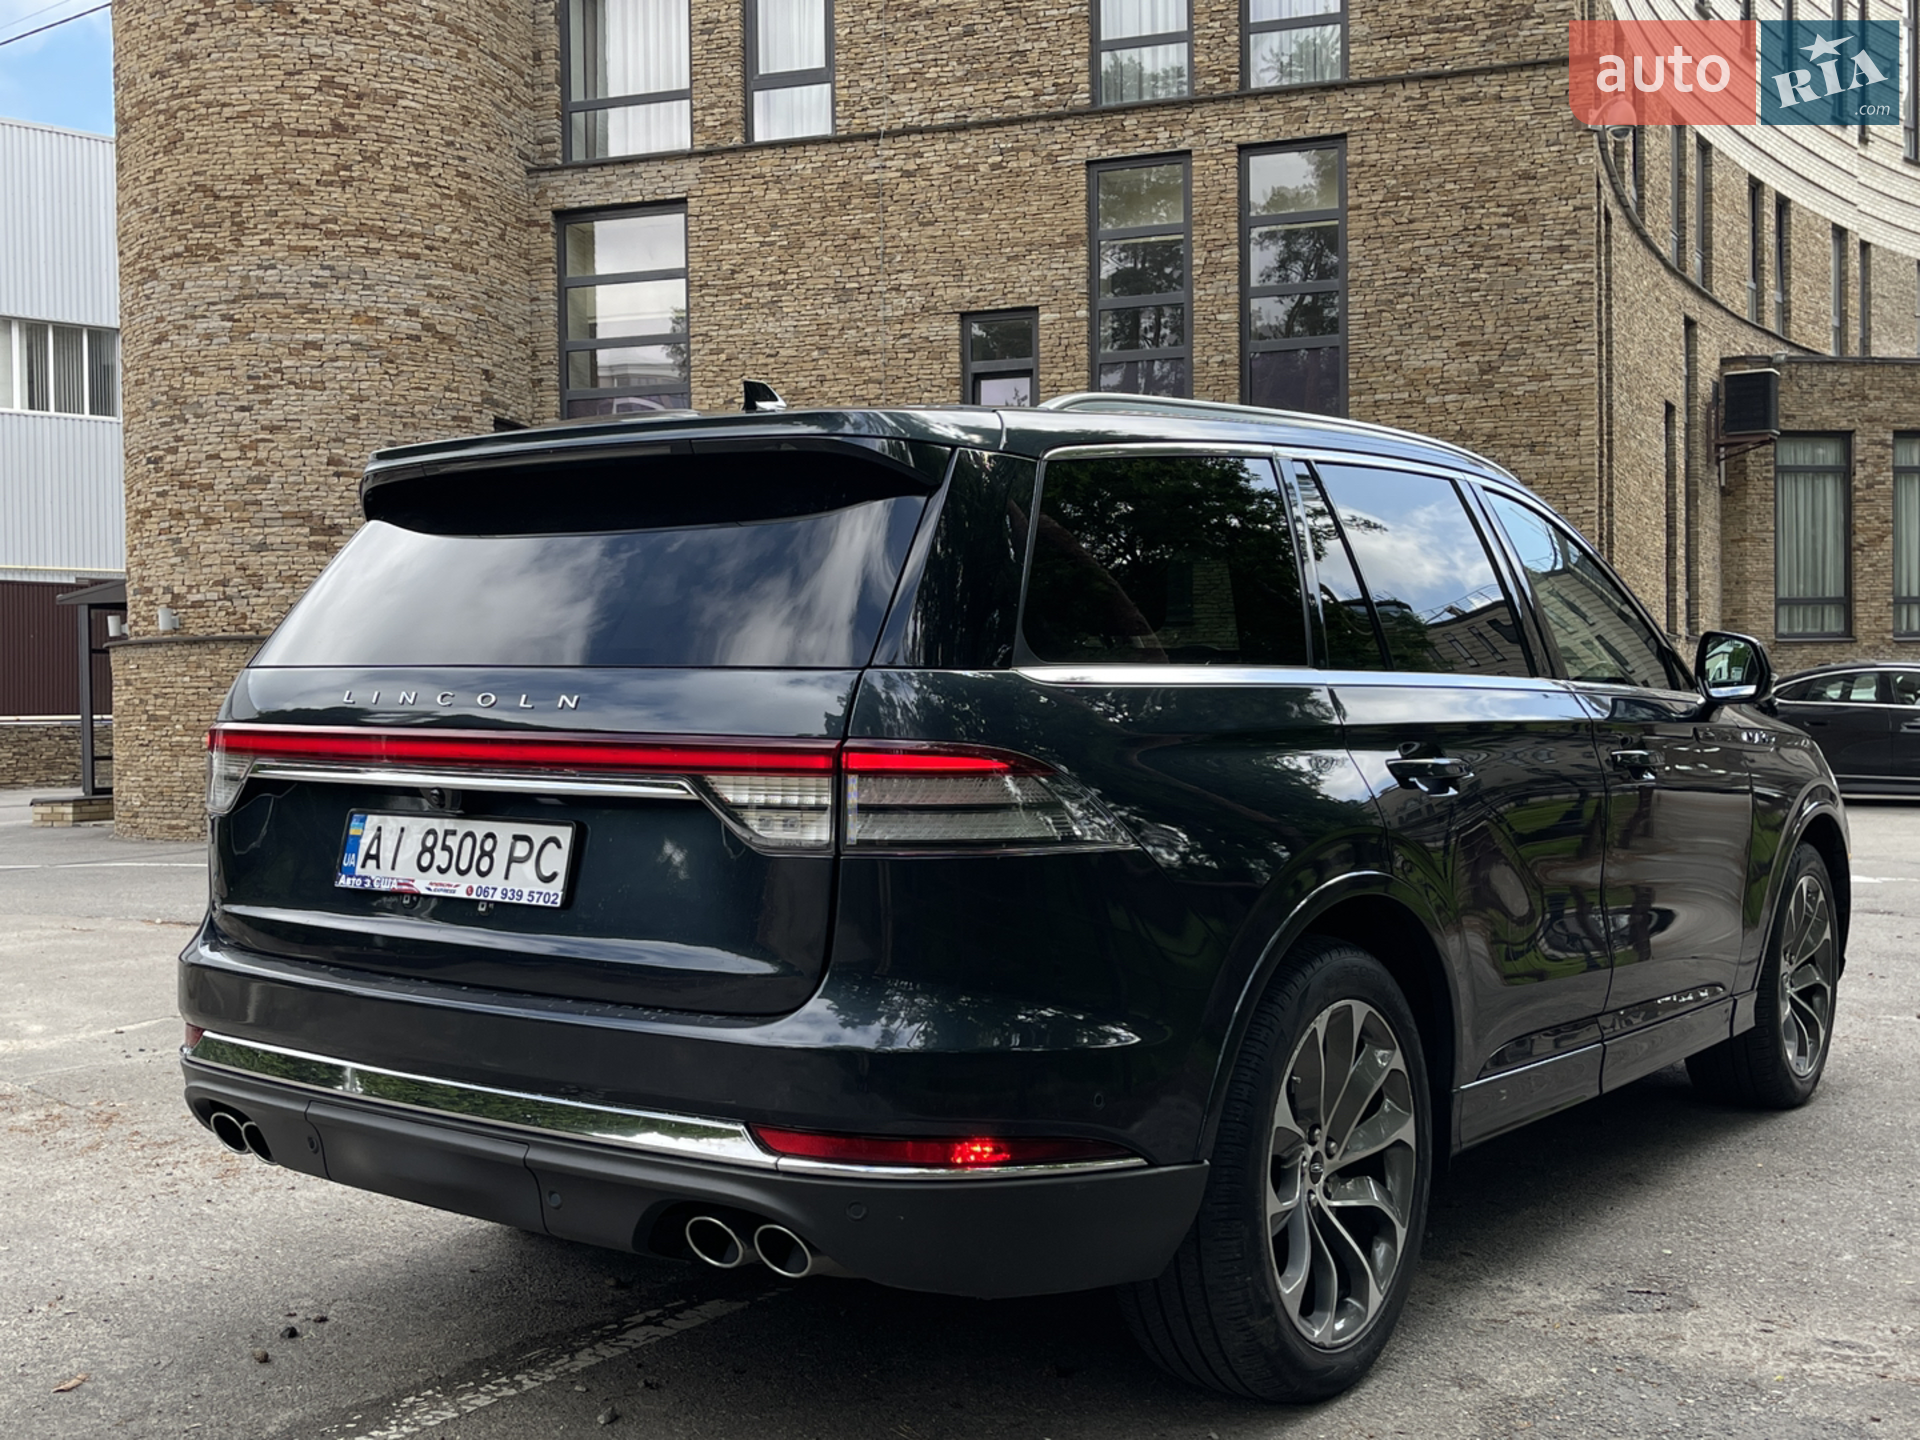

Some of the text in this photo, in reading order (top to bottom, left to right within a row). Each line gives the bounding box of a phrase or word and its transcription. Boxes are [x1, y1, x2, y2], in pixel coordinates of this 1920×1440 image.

[343, 690, 580, 709] LINCOLN
[343, 853, 356, 867] UA
[361, 825, 563, 883] AI 8508 PC
[373, 877, 398, 889] США
[475, 885, 559, 905] 067 939 5702
